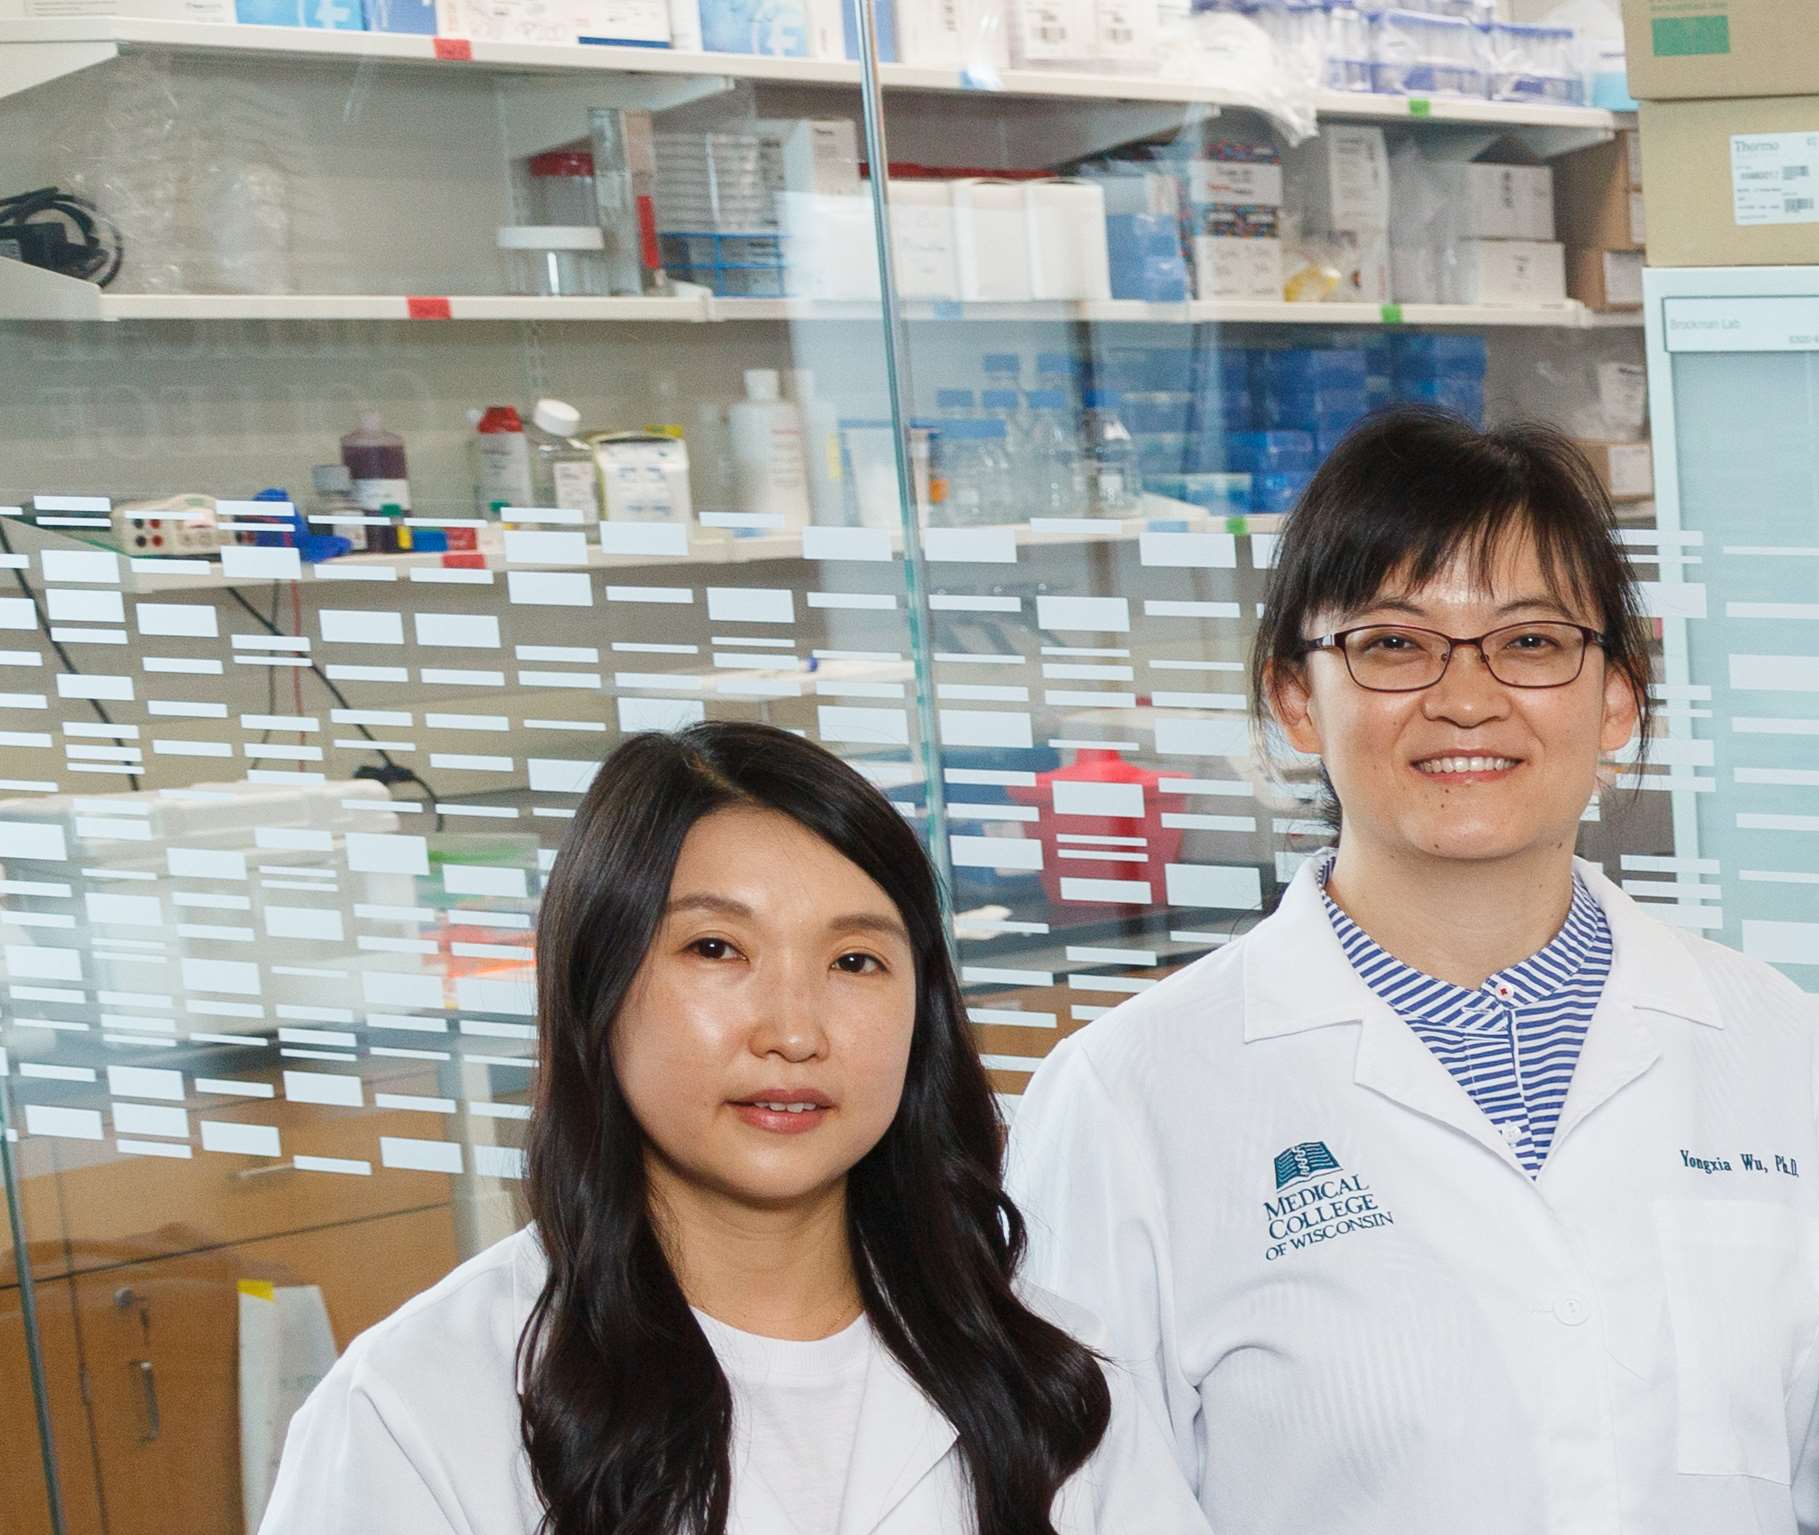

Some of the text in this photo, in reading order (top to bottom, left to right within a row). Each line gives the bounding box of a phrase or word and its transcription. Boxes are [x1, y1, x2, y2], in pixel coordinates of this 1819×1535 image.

[1680, 1149, 1732, 1175] Yongxia
[1740, 1153, 1768, 1174] Wu,
[1264, 1174, 1369, 1221] MEDICAL
[1269, 1194, 1378, 1240] COLLEGE
[1265, 1211, 1394, 1261] OF WISCONSIN
